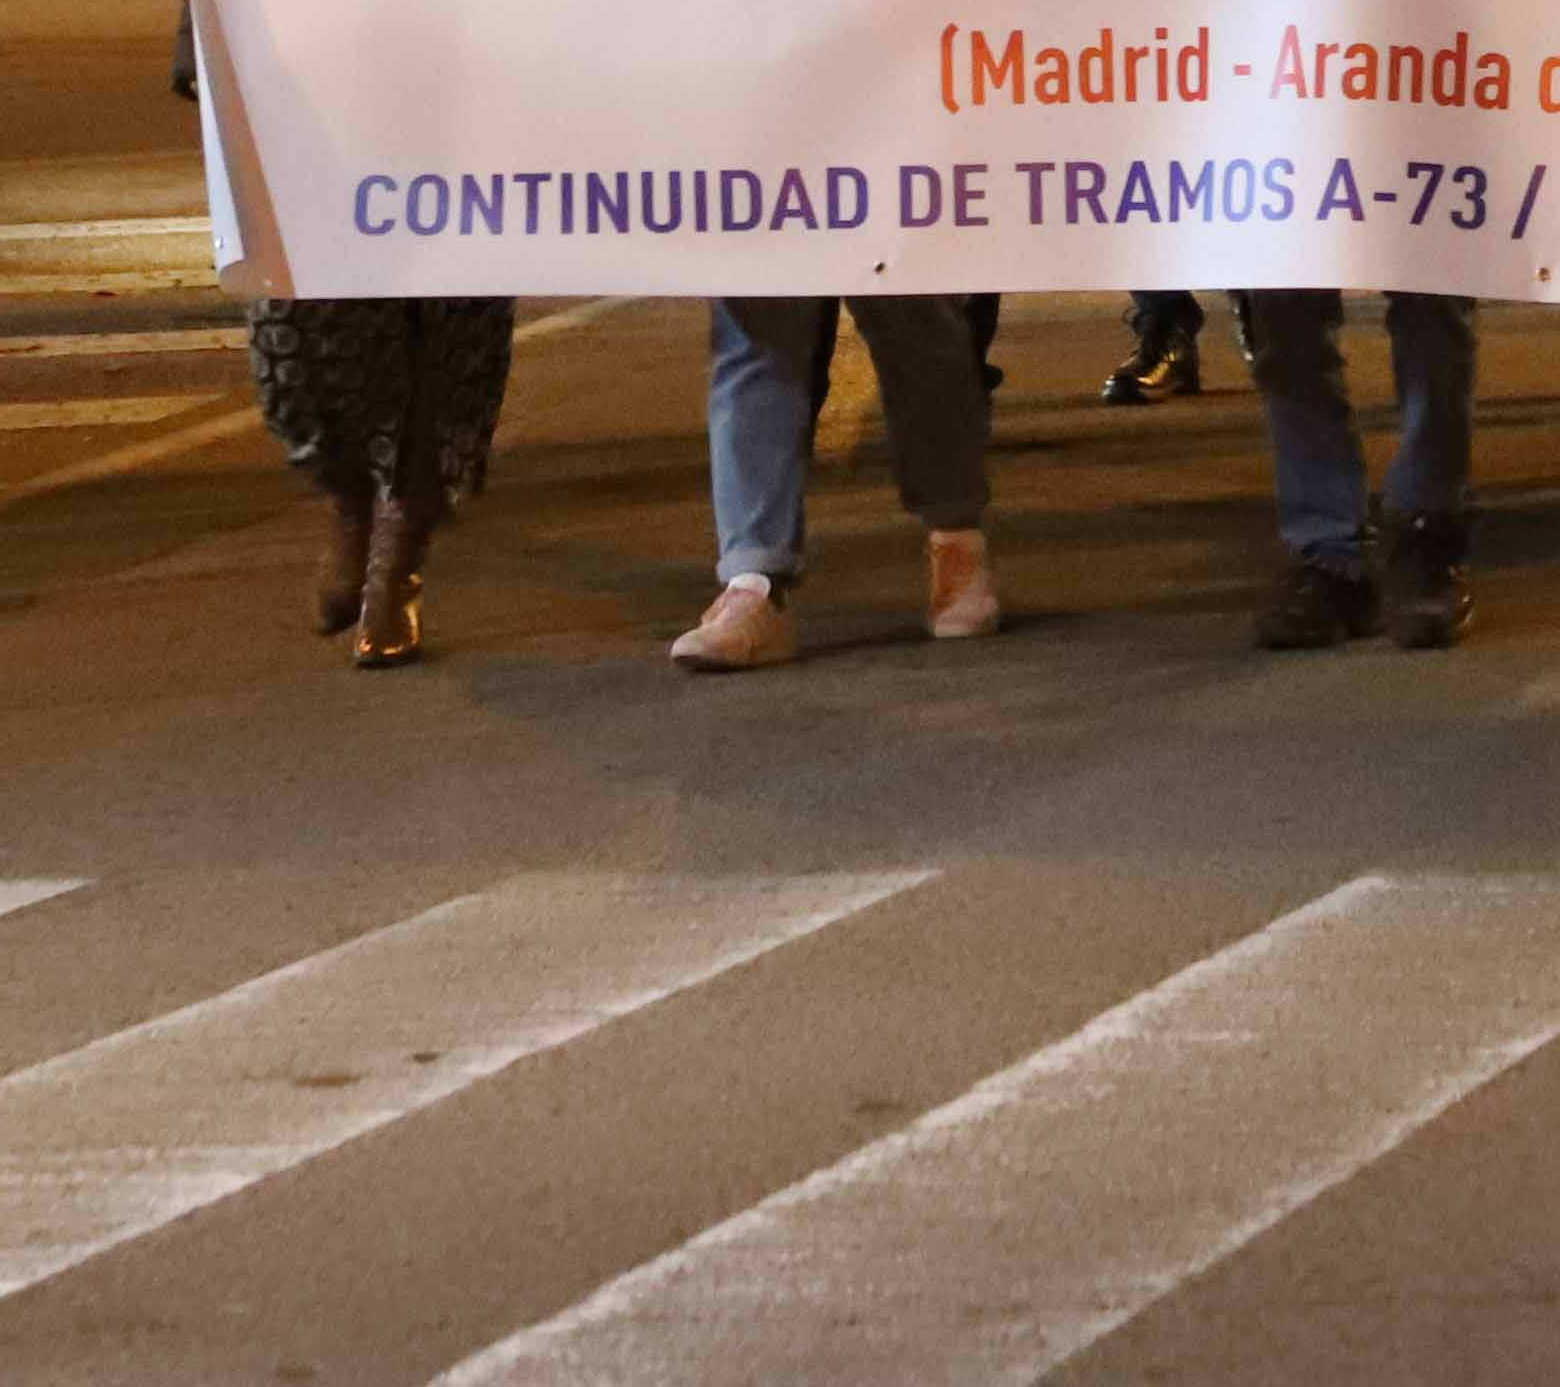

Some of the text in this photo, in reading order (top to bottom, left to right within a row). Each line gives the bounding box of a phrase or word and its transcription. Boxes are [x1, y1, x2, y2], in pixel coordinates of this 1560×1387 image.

[941, 23, 1208, 114] (Madrid
[1233, 66, 1251, 79] -
[1268, 23, 1510, 110] Aranda
[355, 167, 868, 236] CONTINUIDAD
[899, 163, 989, 228] DE
[1015, 157, 1298, 225] TRAMOS
[1318, 158, 1487, 230] A-73
[1511, 165, 1546, 239] /
